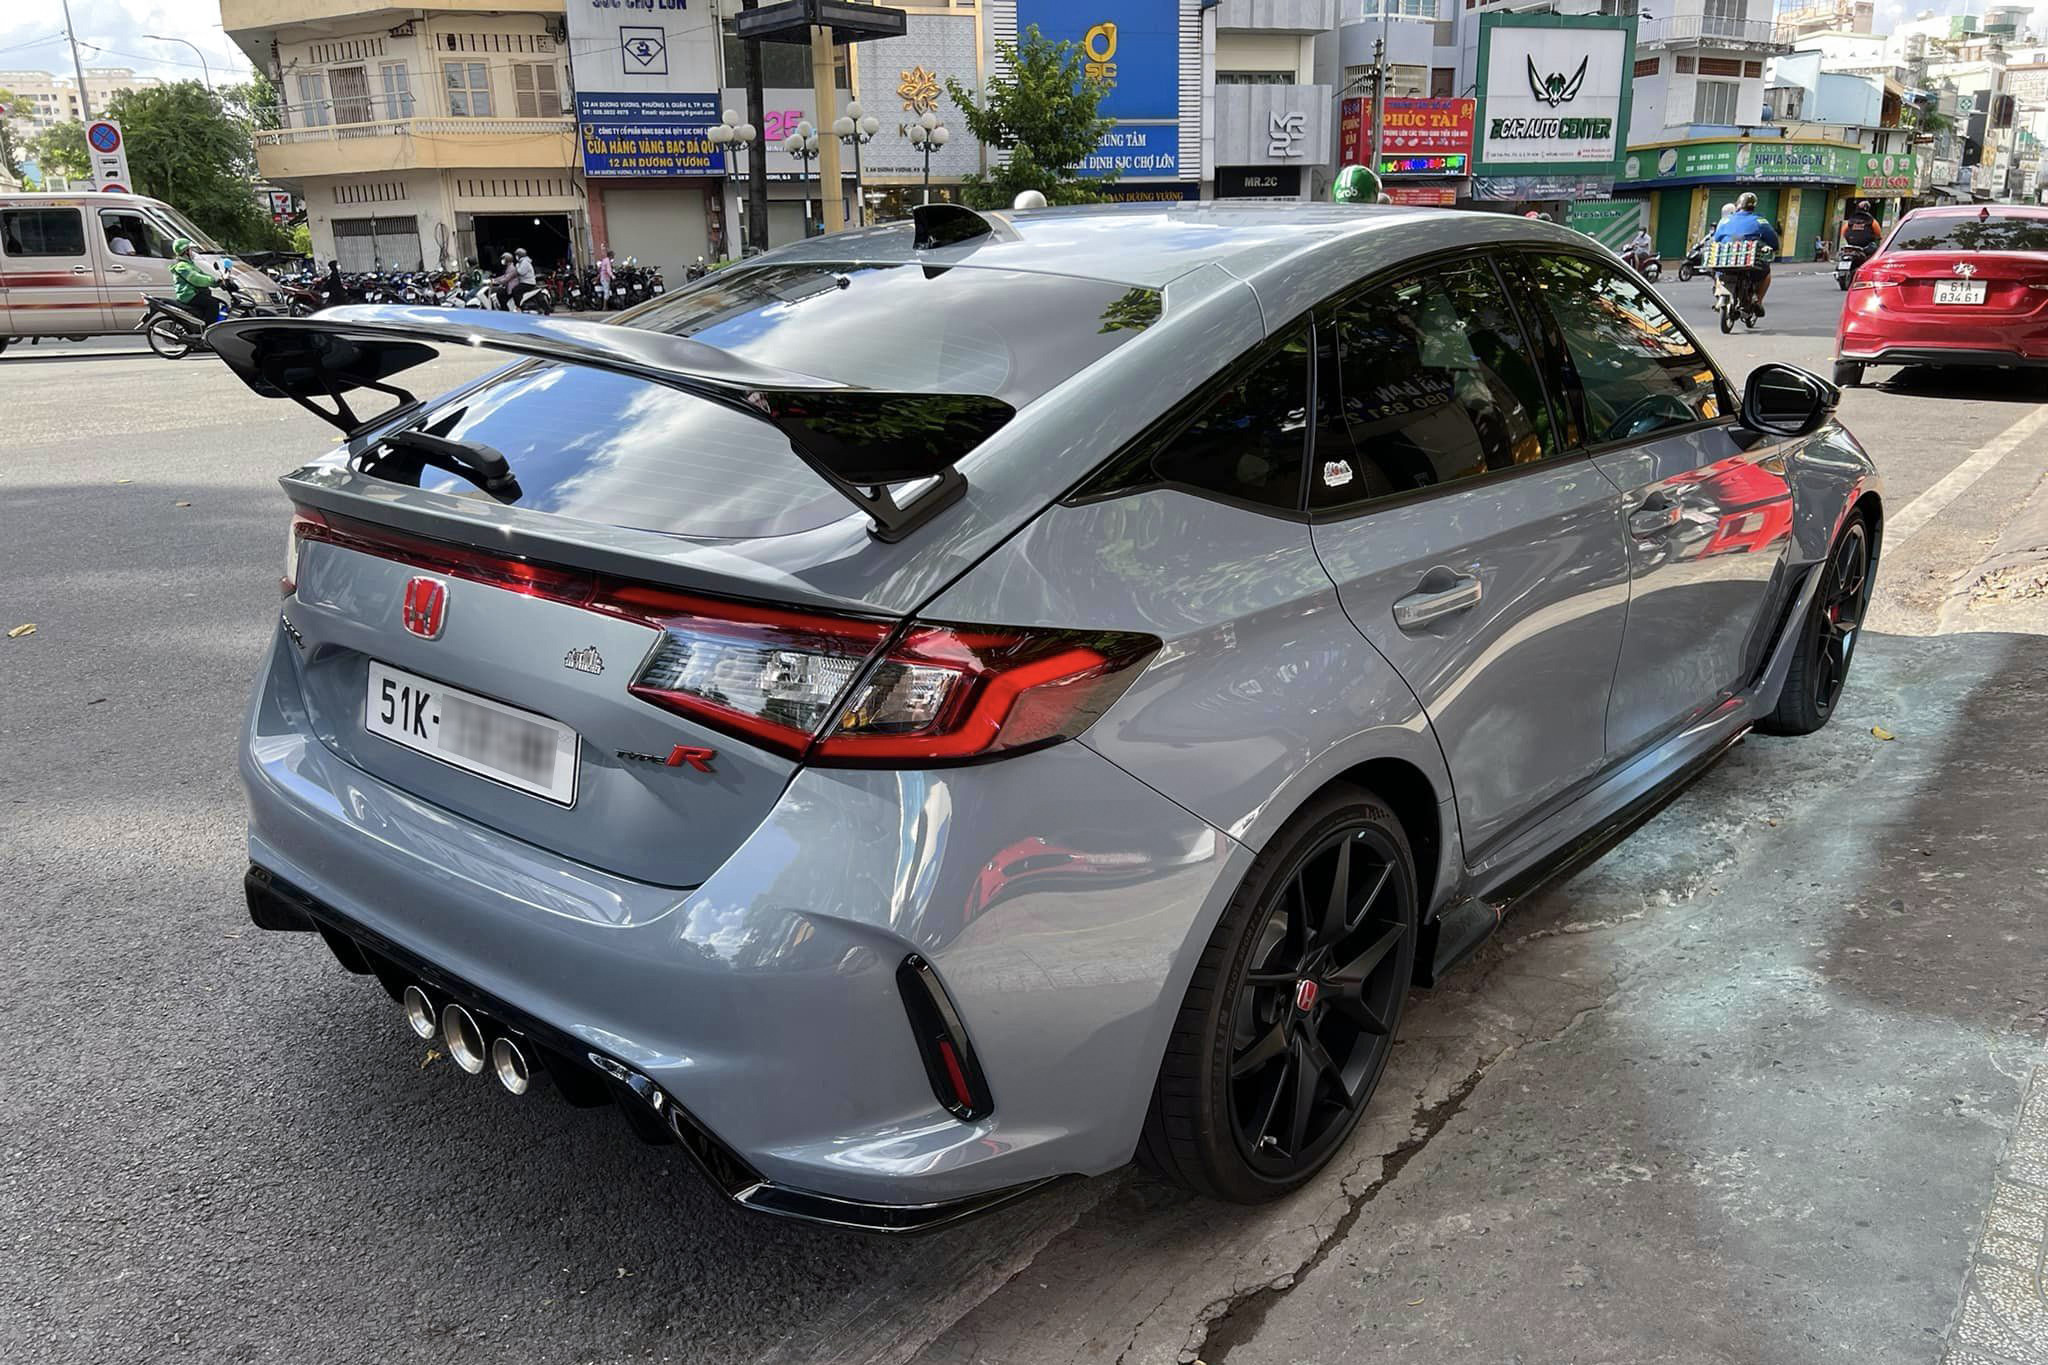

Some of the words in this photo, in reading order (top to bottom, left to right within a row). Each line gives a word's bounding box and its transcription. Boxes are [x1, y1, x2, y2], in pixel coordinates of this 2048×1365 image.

[1085, 63, 1117, 80] SJC
[1383, 110, 1426, 127] PHÚC
[1430, 110, 1458, 127] TÀI
[1558, 118, 1613, 139] CENTER
[587, 136, 608, 154] CỬA
[609, 136, 637, 154] HÀNG
[639, 137, 665, 154] VÀNG
[667, 140, 686, 157] BẠC
[687, 137, 700, 154] ĐÁ
[1126, 131, 1147, 147] TÂM
[608, 159, 620, 167] 12
[622, 158, 636, 167] AN
[638, 157, 674, 167] DƯƠNG
[675, 157, 710, 167] VƯƠNG
[1115, 156, 1132, 169] SJC
[1133, 153, 1154, 171] CHỢ
[1244, 176, 1278, 188] MR.2C
[1950, 282, 1972, 292] 61A
[615, 748, 667, 766] TYPE
